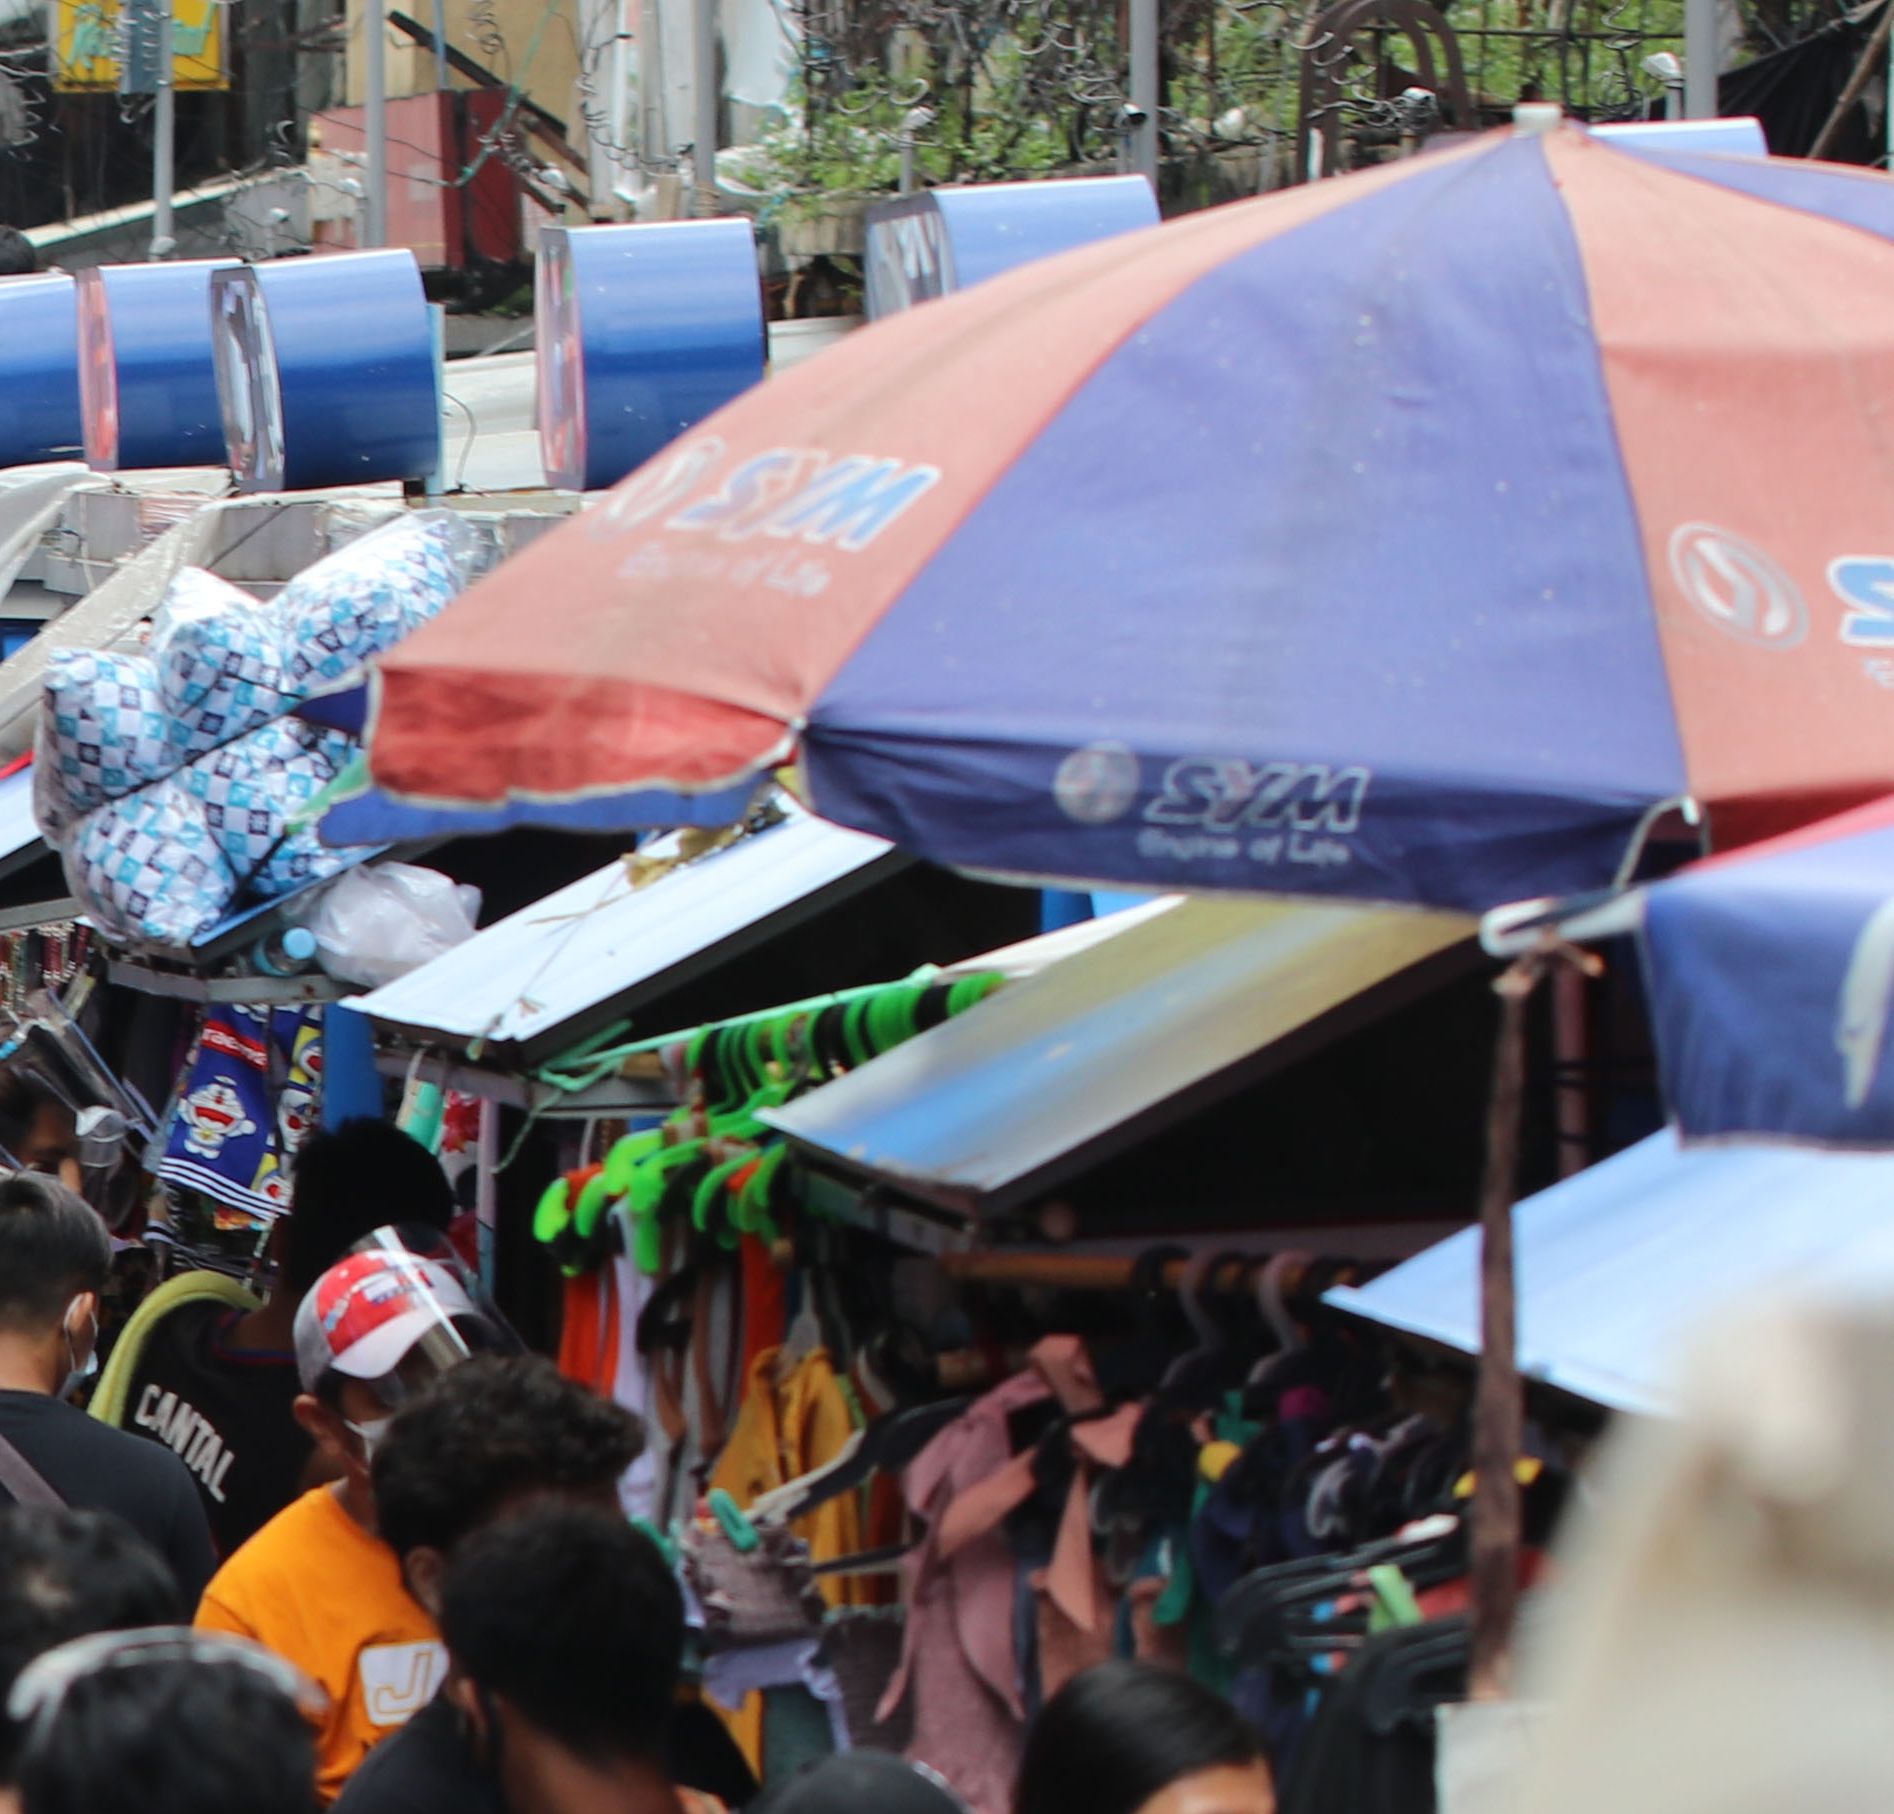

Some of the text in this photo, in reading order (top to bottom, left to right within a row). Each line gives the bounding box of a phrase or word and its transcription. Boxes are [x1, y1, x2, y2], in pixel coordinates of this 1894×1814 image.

[665, 446, 942, 552] SYM
[1142, 756, 1371, 833] SYM
[134, 1383, 236, 1503] CANTAL
